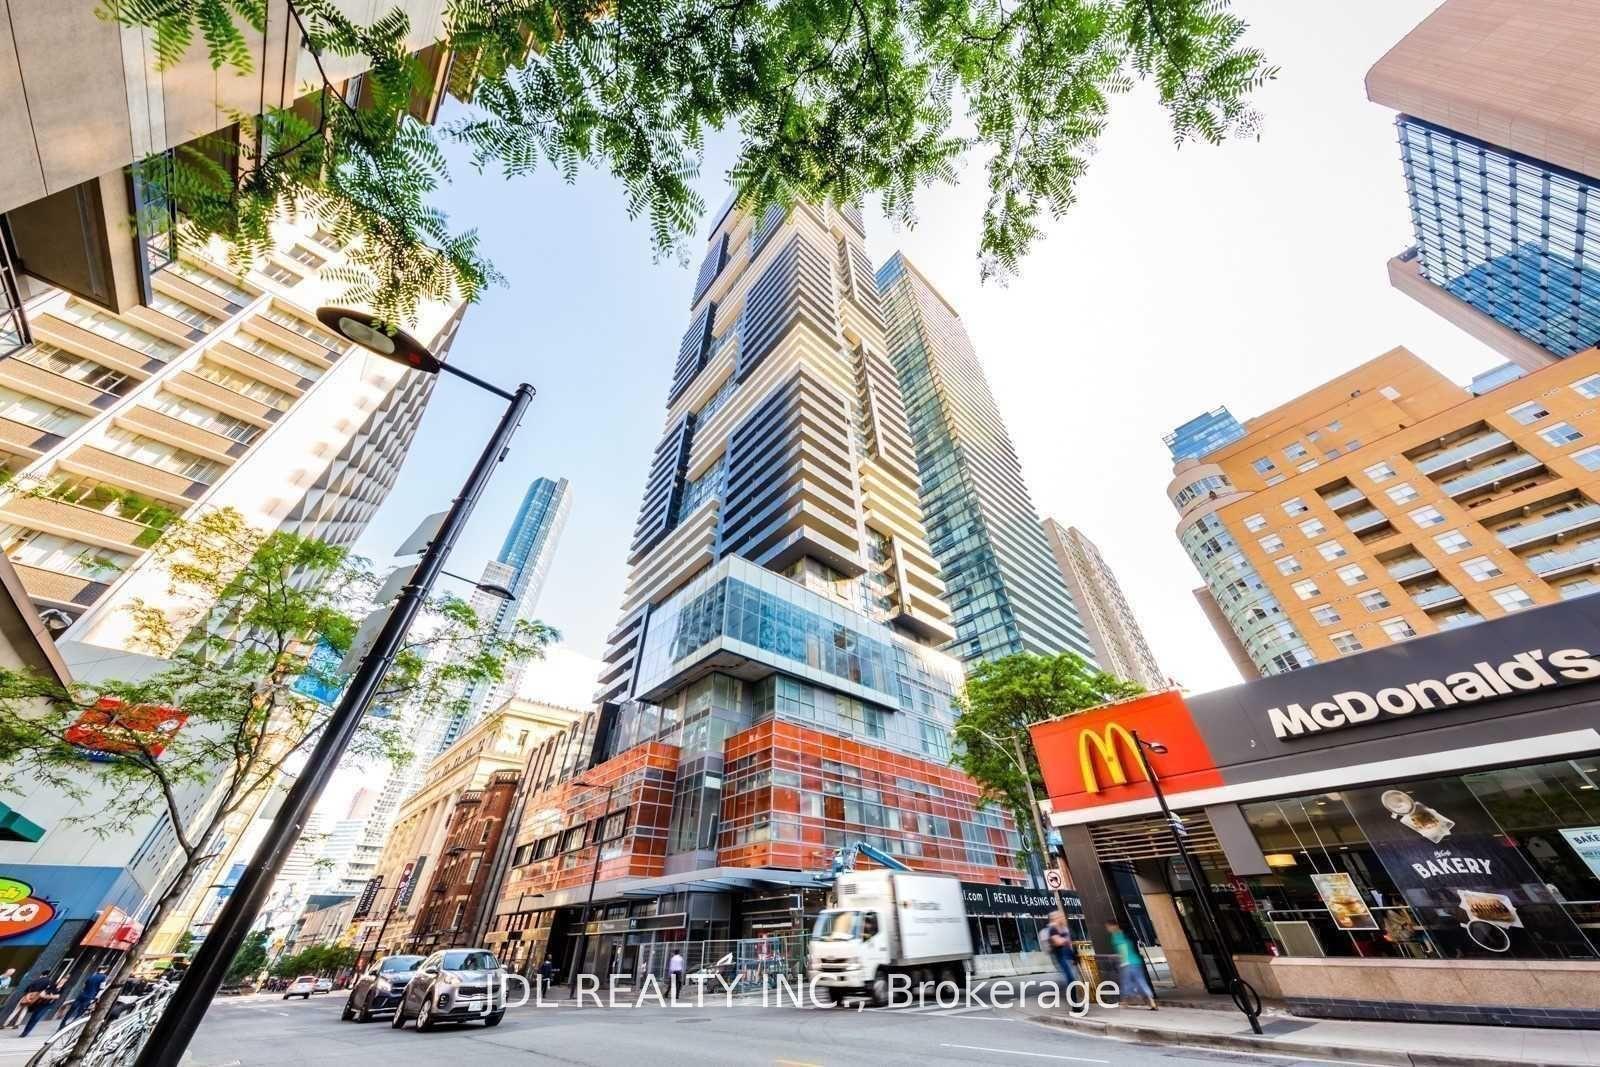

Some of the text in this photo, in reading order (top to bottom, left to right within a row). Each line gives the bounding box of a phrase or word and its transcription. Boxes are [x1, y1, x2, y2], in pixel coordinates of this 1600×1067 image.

[1267, 649, 1600, 738] McDonald's
[1411, 858, 1492, 879] BAKERY
[993, 892, 1019, 905] RETAIL
[1020, 895, 1050, 907] LEASING
